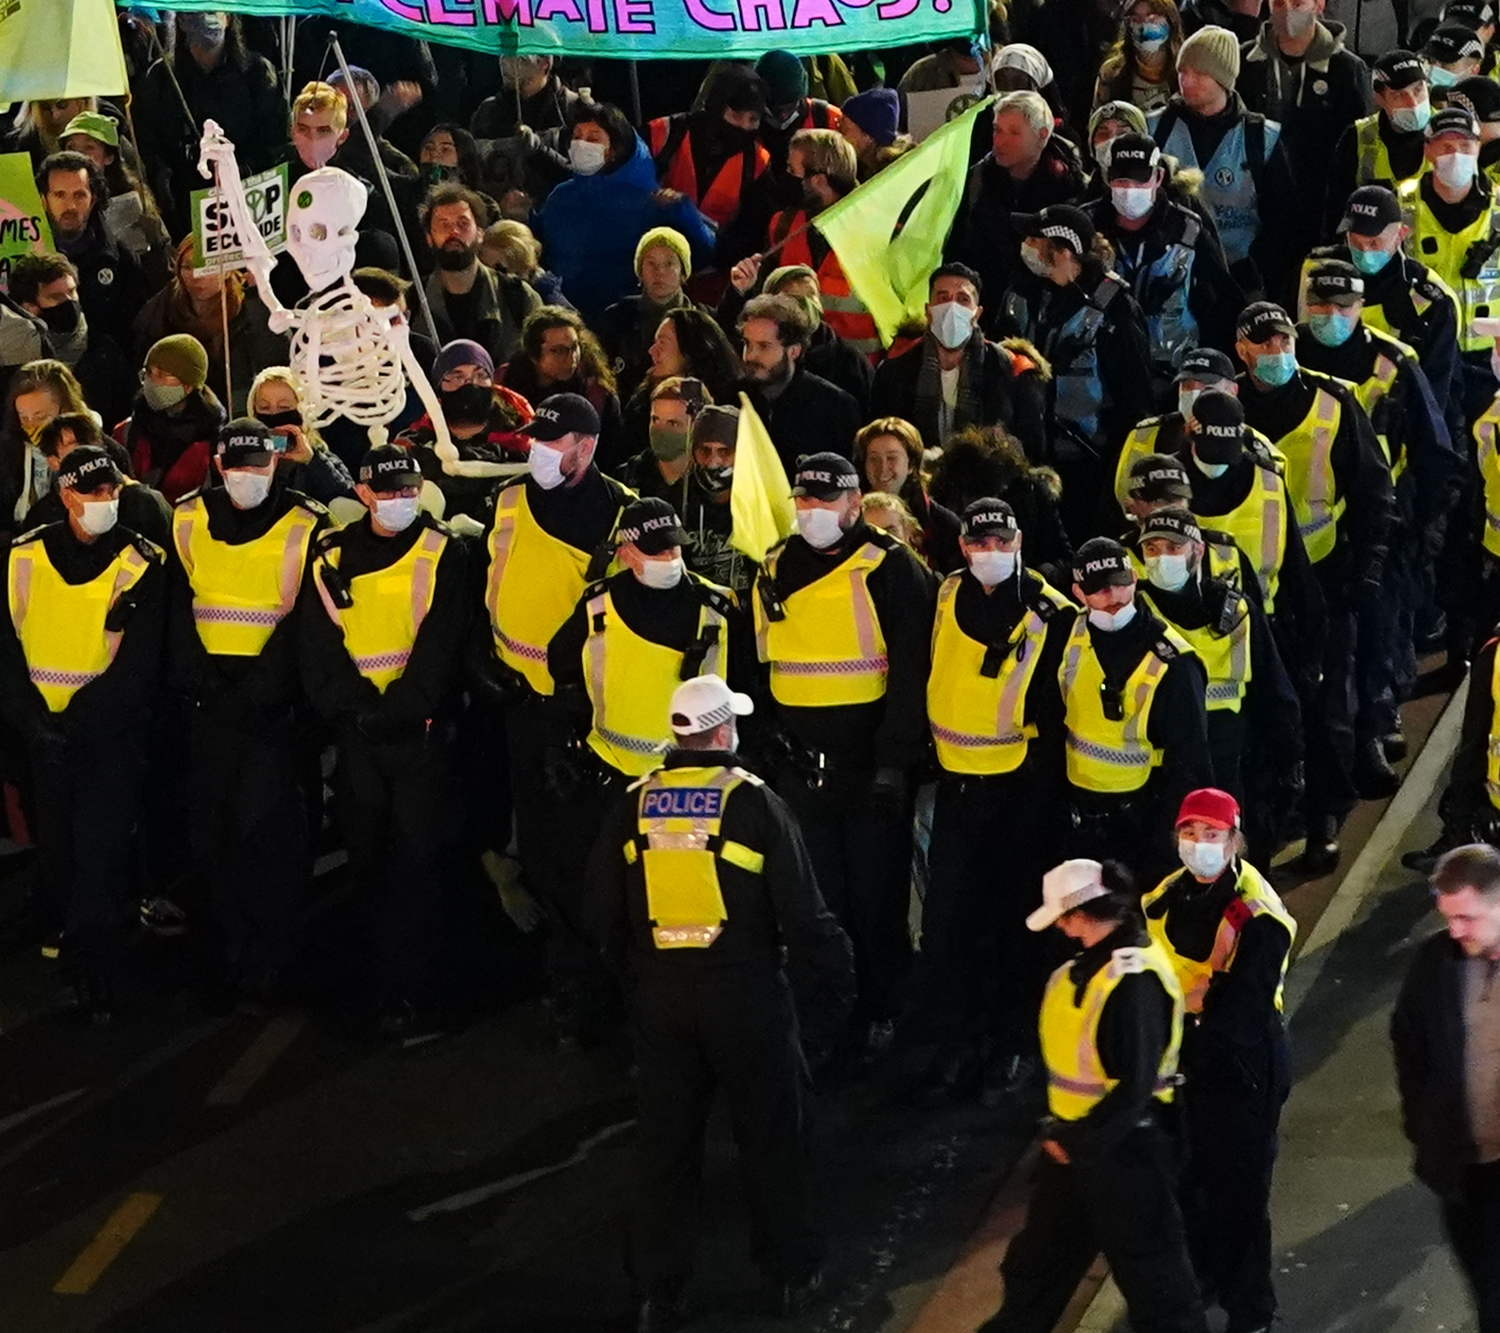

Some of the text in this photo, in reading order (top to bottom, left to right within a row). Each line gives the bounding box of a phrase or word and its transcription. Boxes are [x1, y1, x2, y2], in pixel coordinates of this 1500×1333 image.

[1116, 148, 1147, 161] POLICE
[1351, 201, 1379, 217] POLICE
[206, 216, 282, 253] ECOIDE
[1254, 311, 1286, 326] POLICE
[1206, 425, 1237, 438] POLICE
[229, 435, 260, 448] POLICE
[79, 457, 111, 477] POLICE
[377, 459, 409, 473] POLICE
[801, 470, 832, 484] POLICE
[1149, 469, 1181, 482] POLICE
[643, 517, 675, 533] POLICE
[971, 512, 1004, 526] POLICE
[1149, 517, 1181, 530] POLICE
[1086, 558, 1119, 573] POLICE
[643, 790, 719, 815] POLICE
